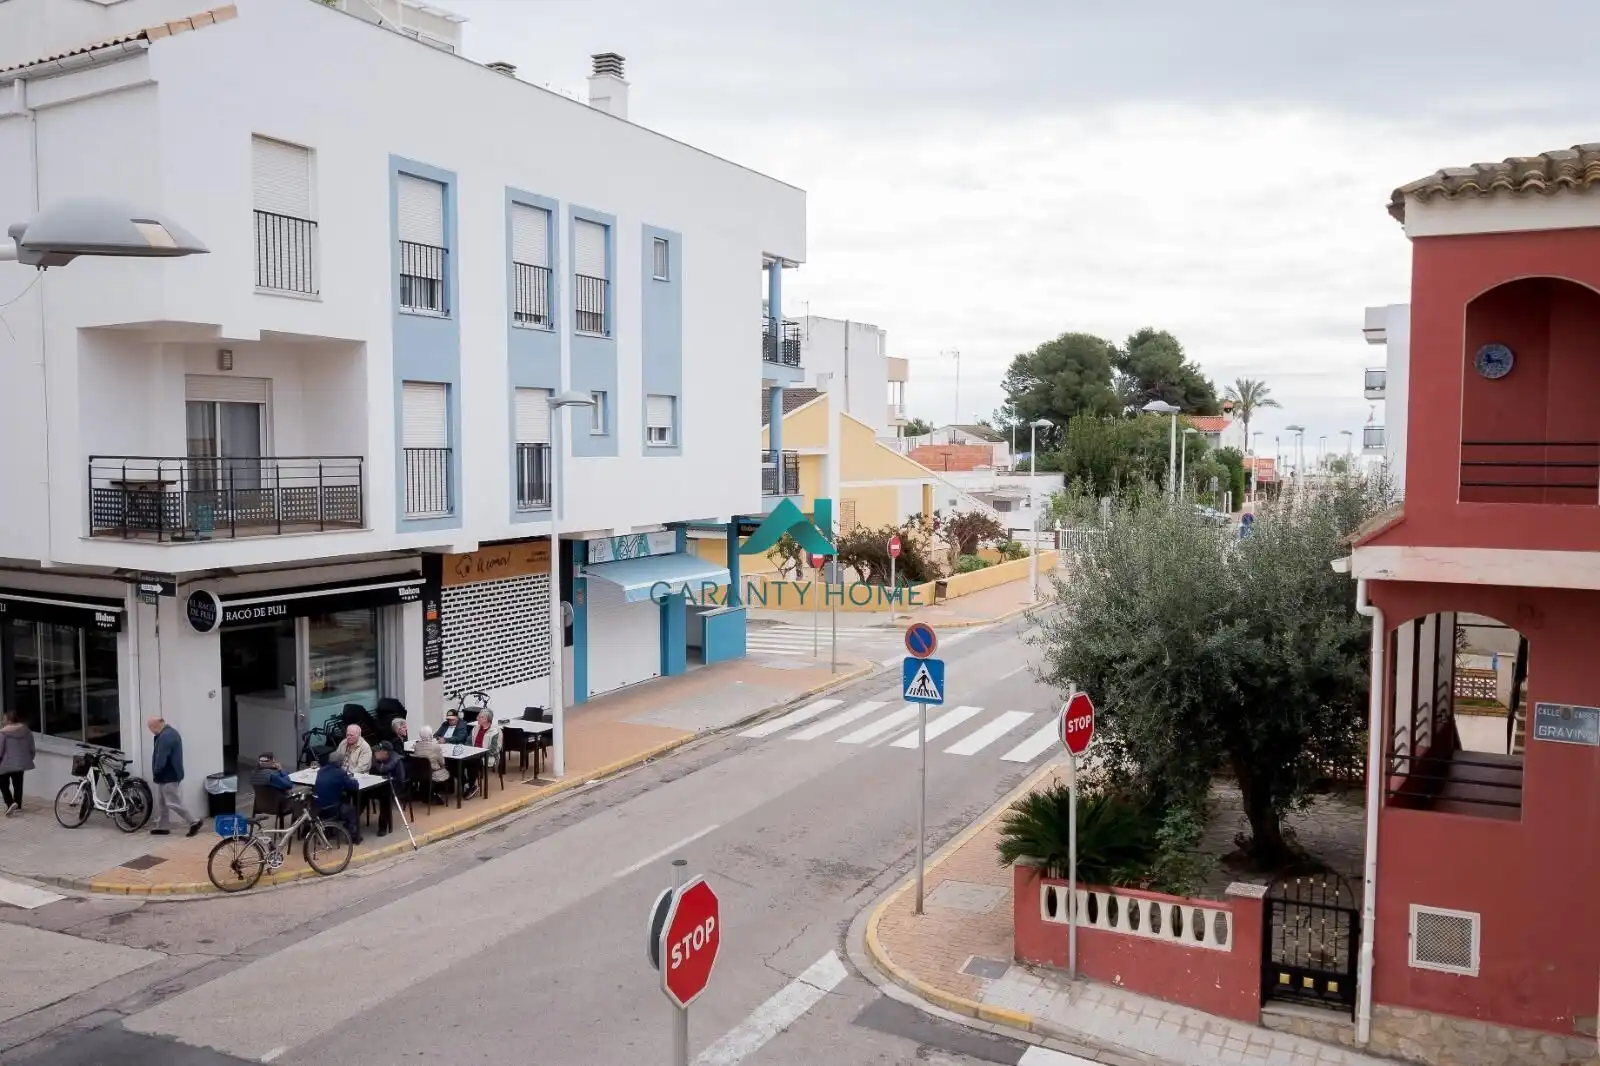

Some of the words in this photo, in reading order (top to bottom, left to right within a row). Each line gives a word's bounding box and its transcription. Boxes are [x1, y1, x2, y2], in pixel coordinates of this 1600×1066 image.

[226, 607, 251, 621] RACÓ
[253, 607, 266, 617] DE
[267, 605, 287, 616] PULI
[1537, 707, 1560, 717] CALLE
[1068, 714, 1092, 733] STOP
[671, 916, 715, 970] STOP
